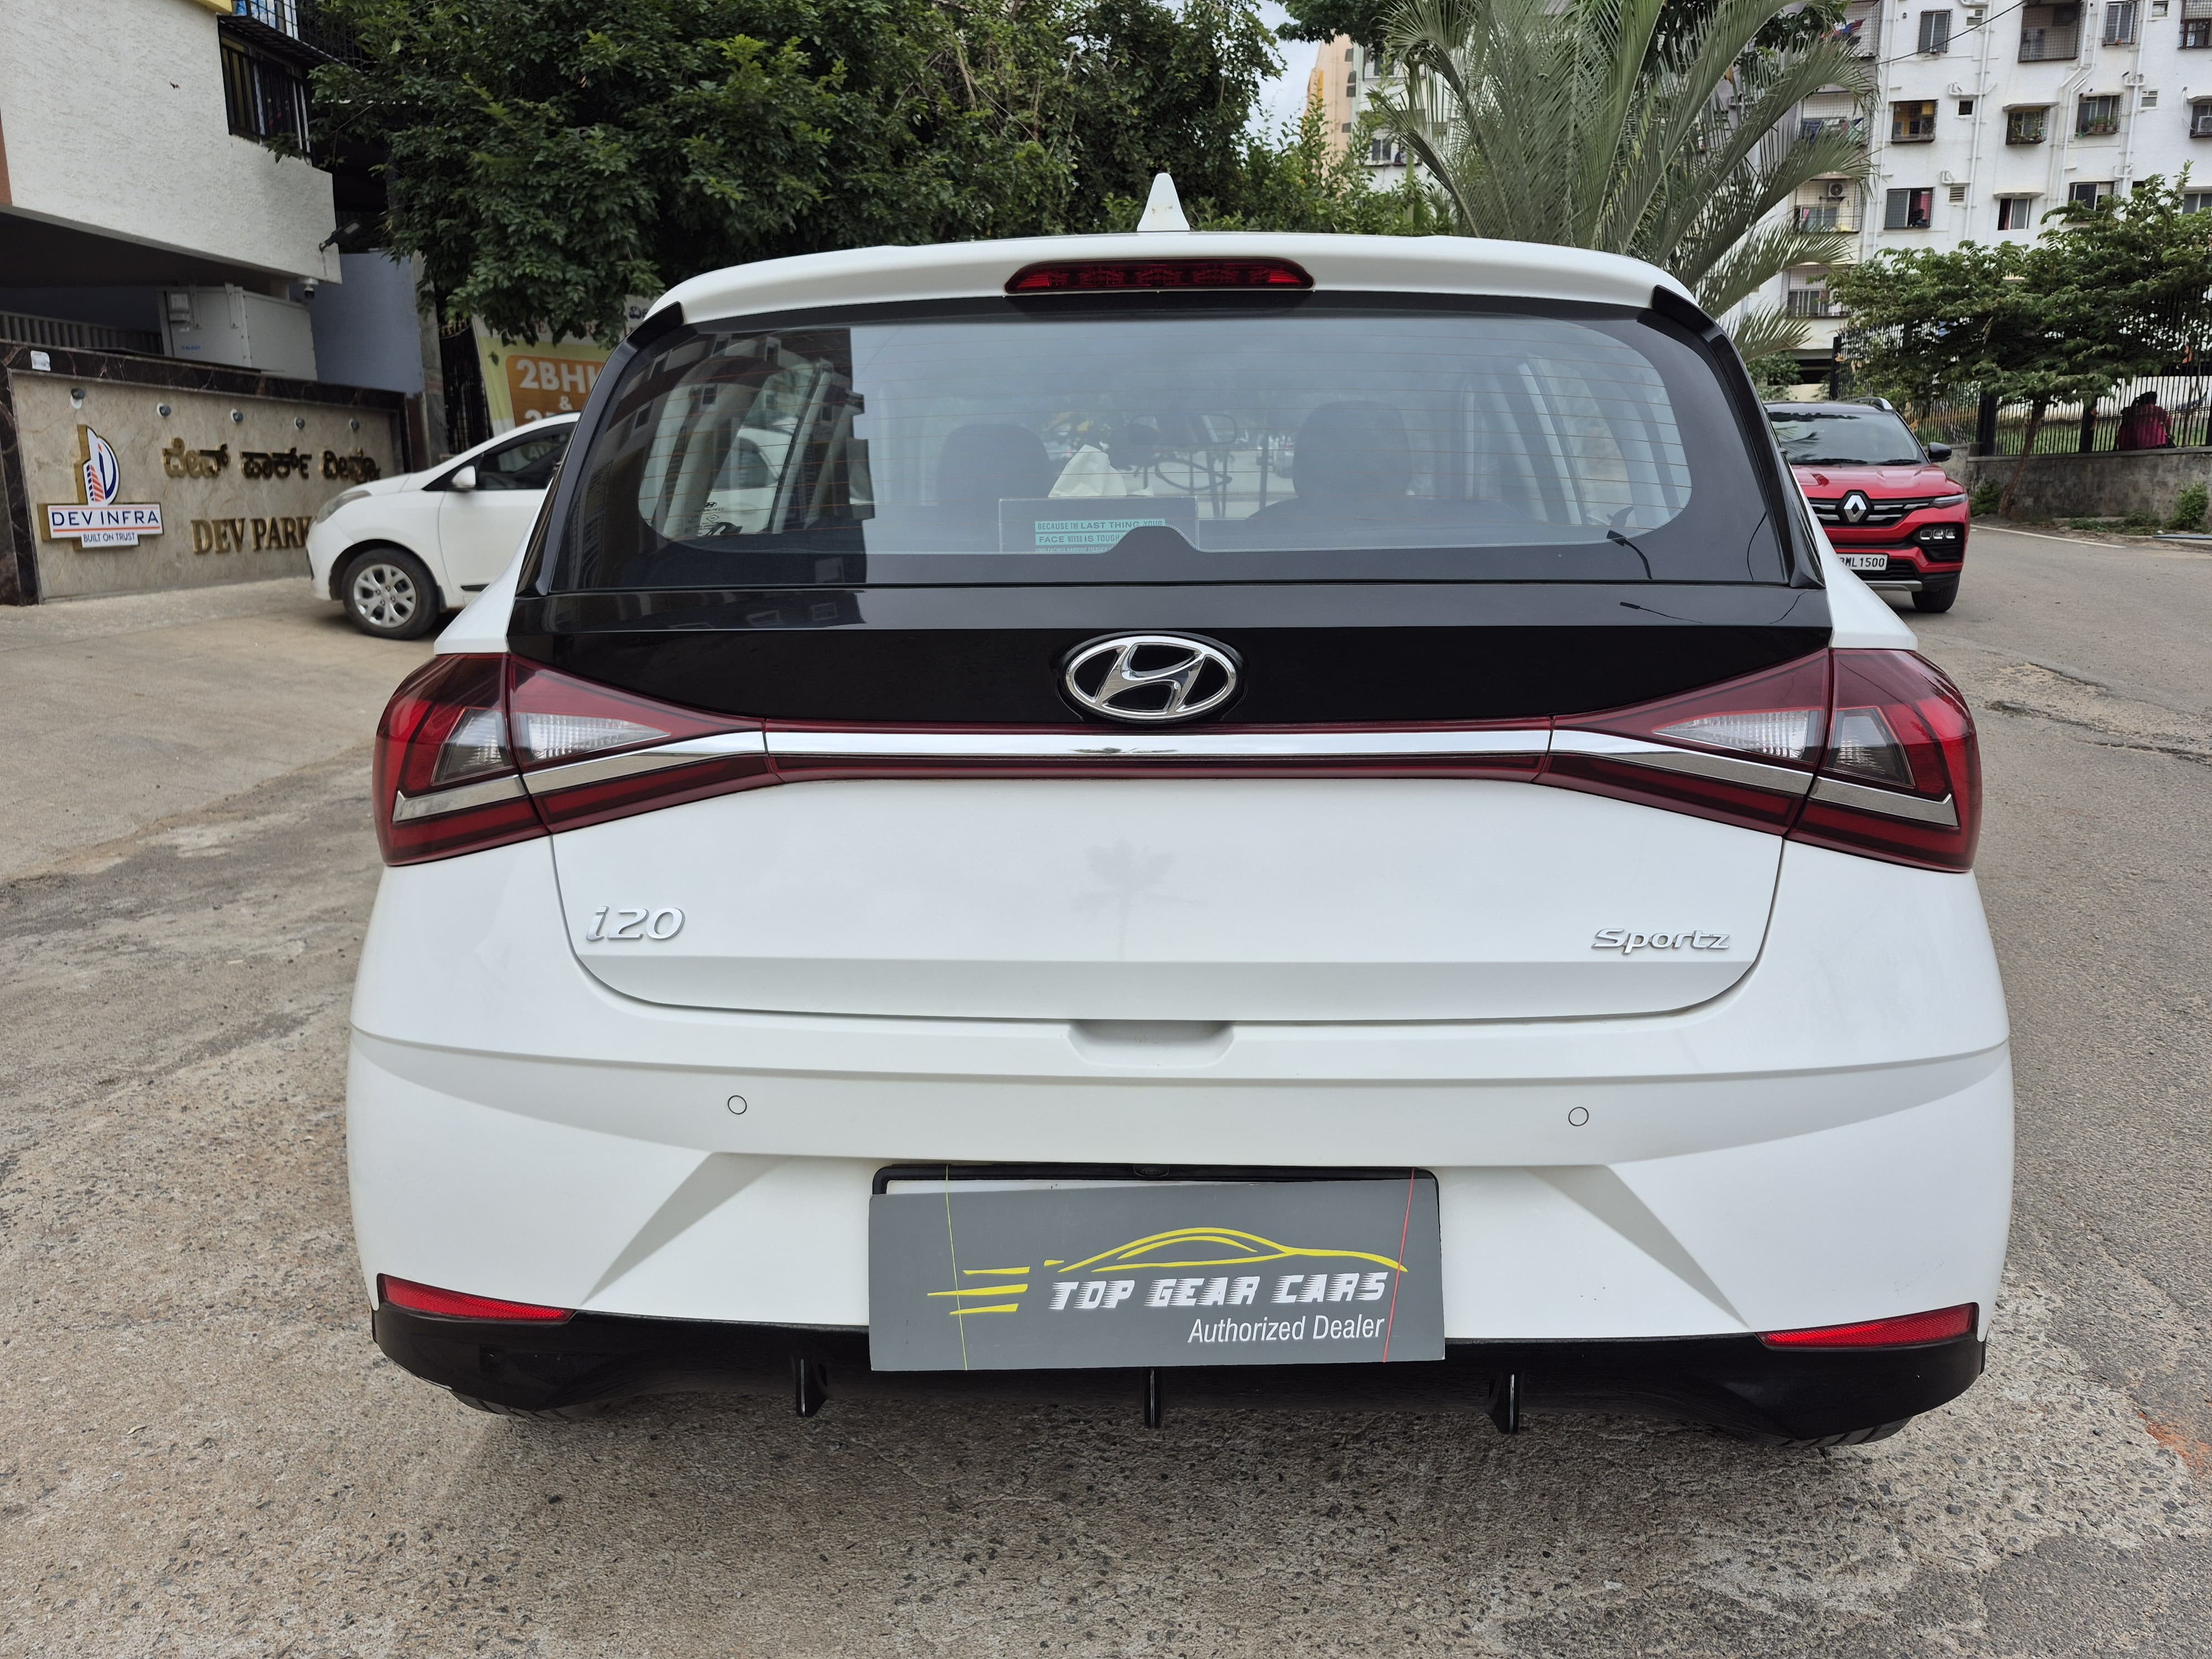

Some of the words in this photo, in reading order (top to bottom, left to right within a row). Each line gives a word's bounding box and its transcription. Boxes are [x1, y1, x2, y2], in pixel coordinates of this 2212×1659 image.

[559, 395, 573, 411] &
[51, 511, 93, 526] DEV
[100, 510, 159, 525] INFRA
[83, 533, 101, 542] BUILT
[102, 533, 114, 542] ON
[116, 532, 135, 541] TRUST
[191, 518, 246, 554] DEV
[251, 516, 312, 551] PARK
[586, 905, 686, 942] i20
[1591, 928, 1730, 955] Sportz
[1048, 1279, 1135, 1310] TOP
[1144, 1276, 1261, 1307] GEAR
[1270, 1271, 1389, 1303] CARS
[1187, 1316, 1307, 1343] Authorized
[1313, 1313, 1385, 1340] Dealer
